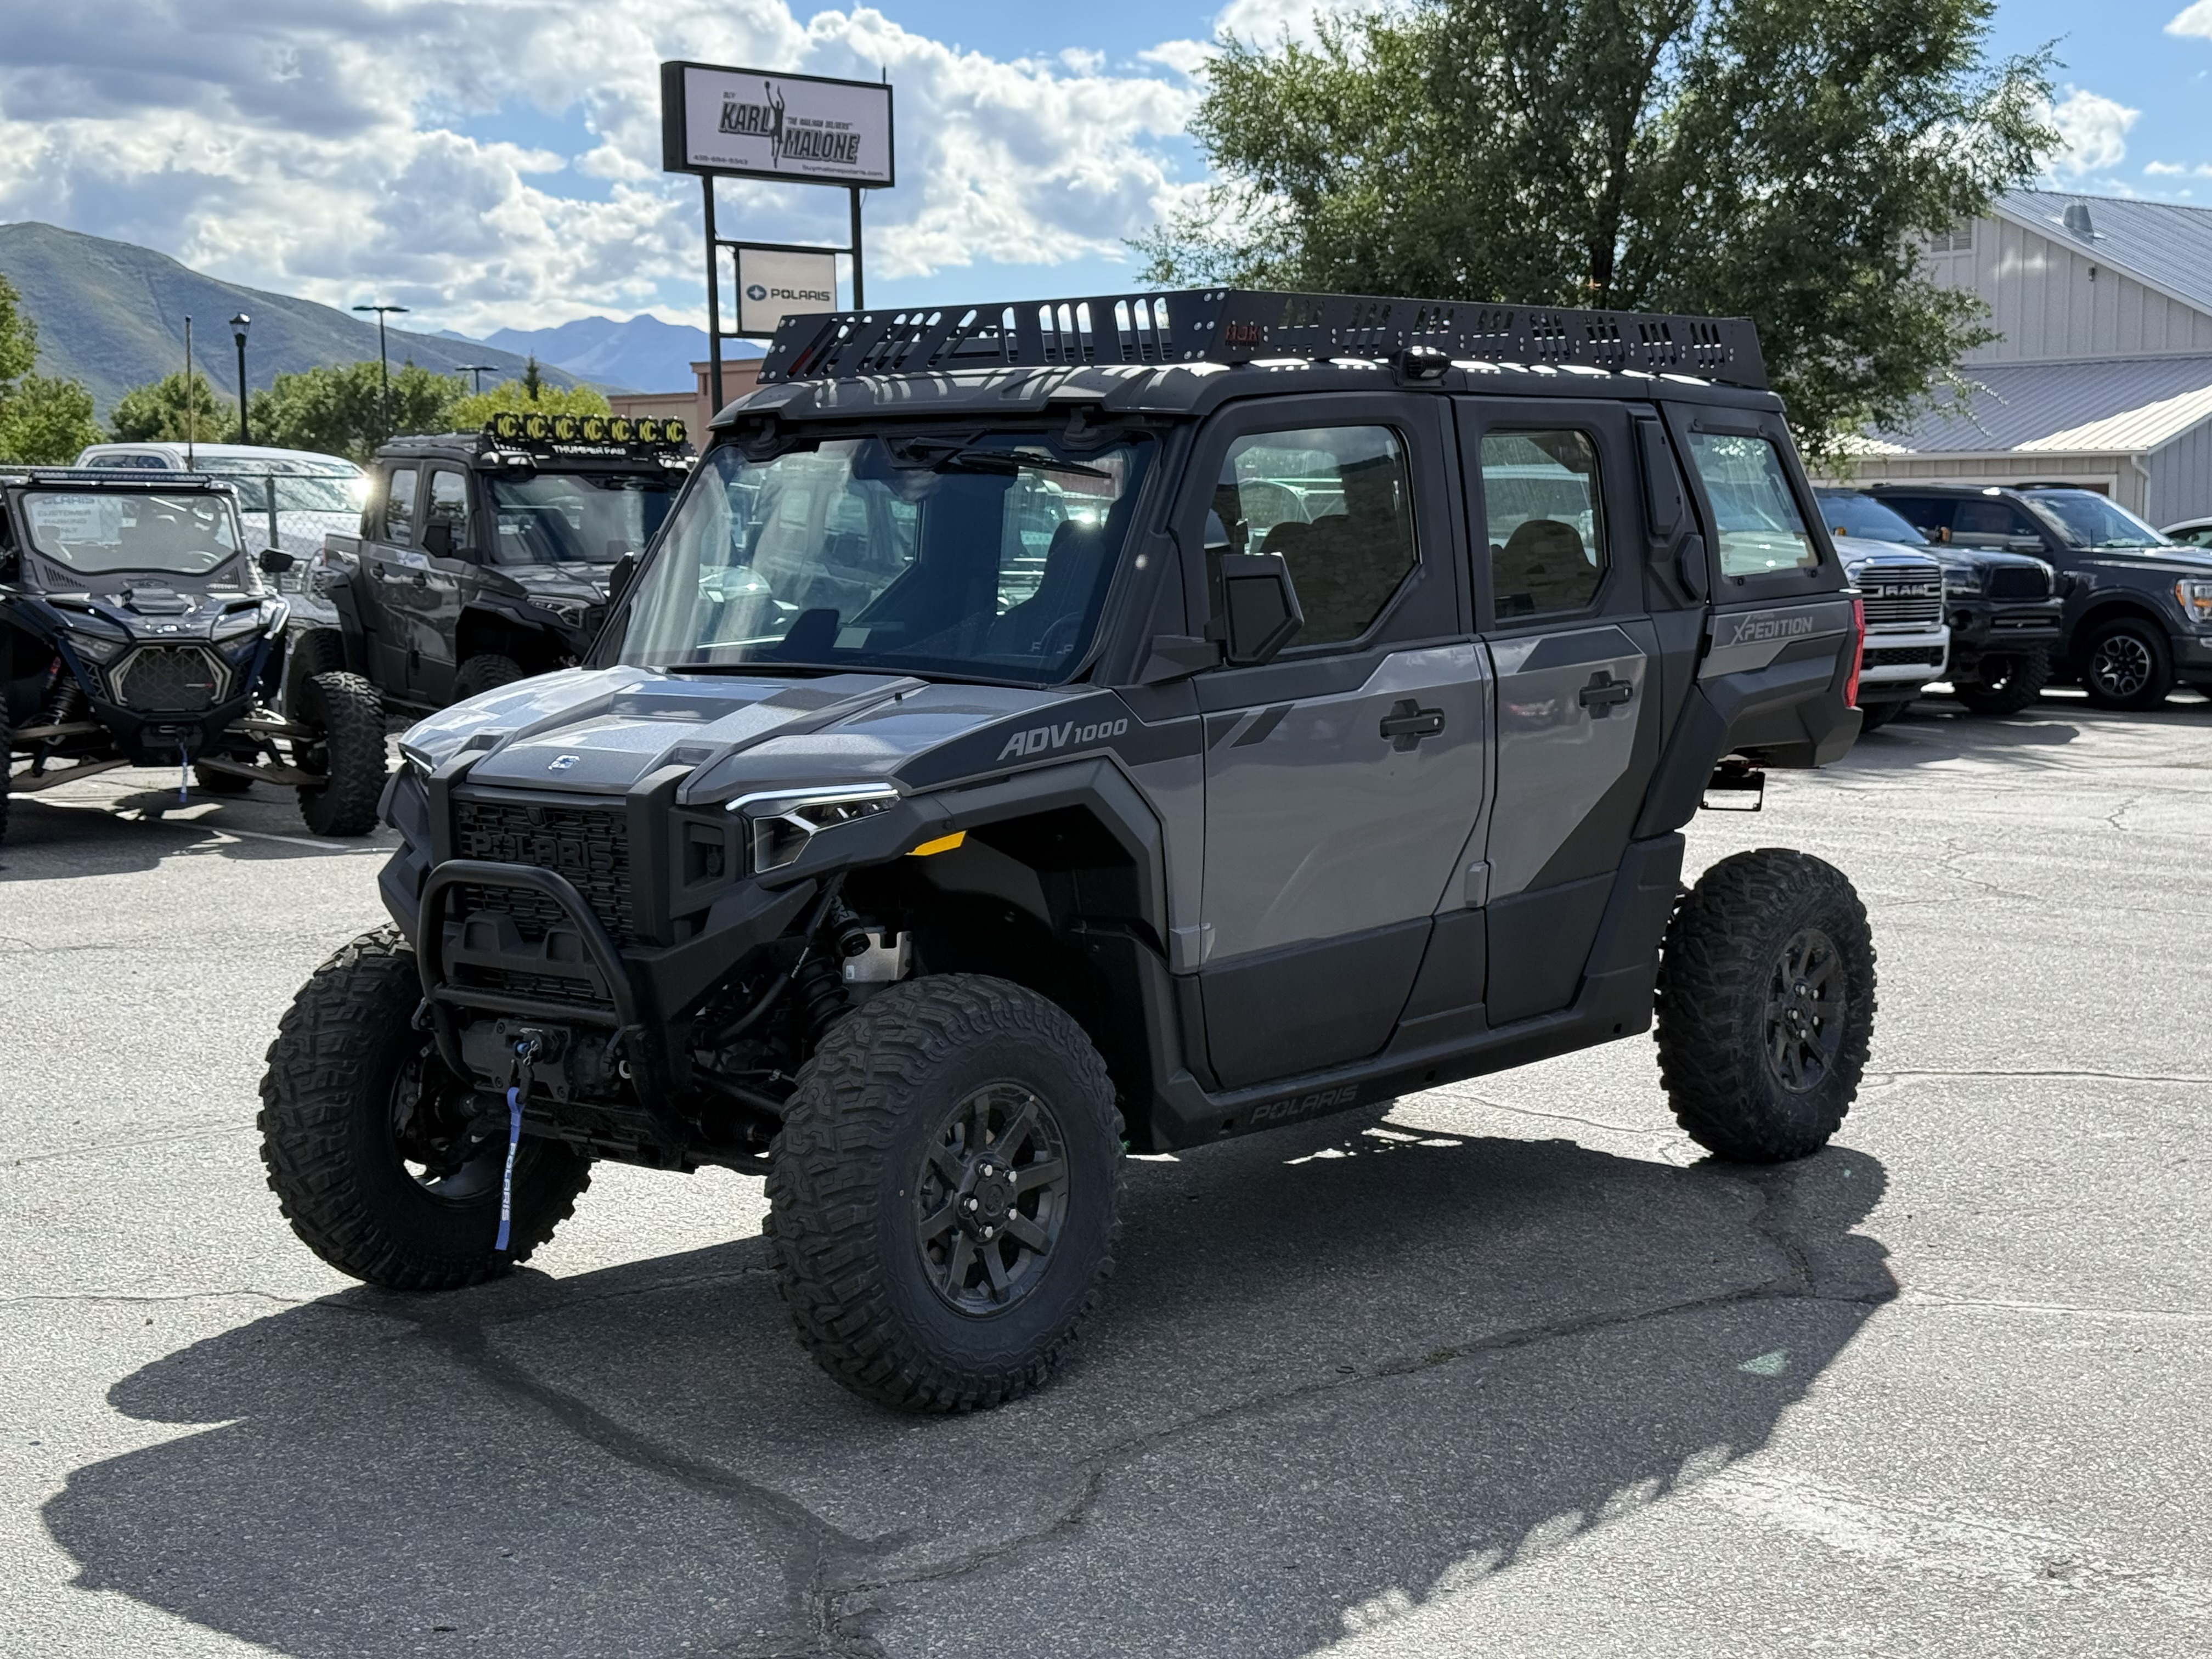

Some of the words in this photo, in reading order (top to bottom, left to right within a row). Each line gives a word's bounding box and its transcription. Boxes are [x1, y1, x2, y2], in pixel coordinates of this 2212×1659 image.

[720, 101, 769, 133] KARL
[782, 128, 859, 163] MALONE
[770, 288, 830, 301] POLARIS
[498, 415, 517, 438] KC
[527, 416, 546, 438] KC
[555, 417, 574, 439] KC
[583, 419, 603, 441] KC
[612, 420, 631, 441] KC
[639, 421, 658, 442] KC
[666, 421, 684, 443] KC
[1886, 585, 1925, 596] RAM
[1730, 614, 1813, 645] XPEDITION
[996, 721, 1074, 761] ADV
[1074, 718, 1128, 744] 1000
[471, 831, 614, 870] POLARIS
[1250, 1084, 1359, 1124] POLARIS
[501, 1142, 517, 1221] POLARIS
